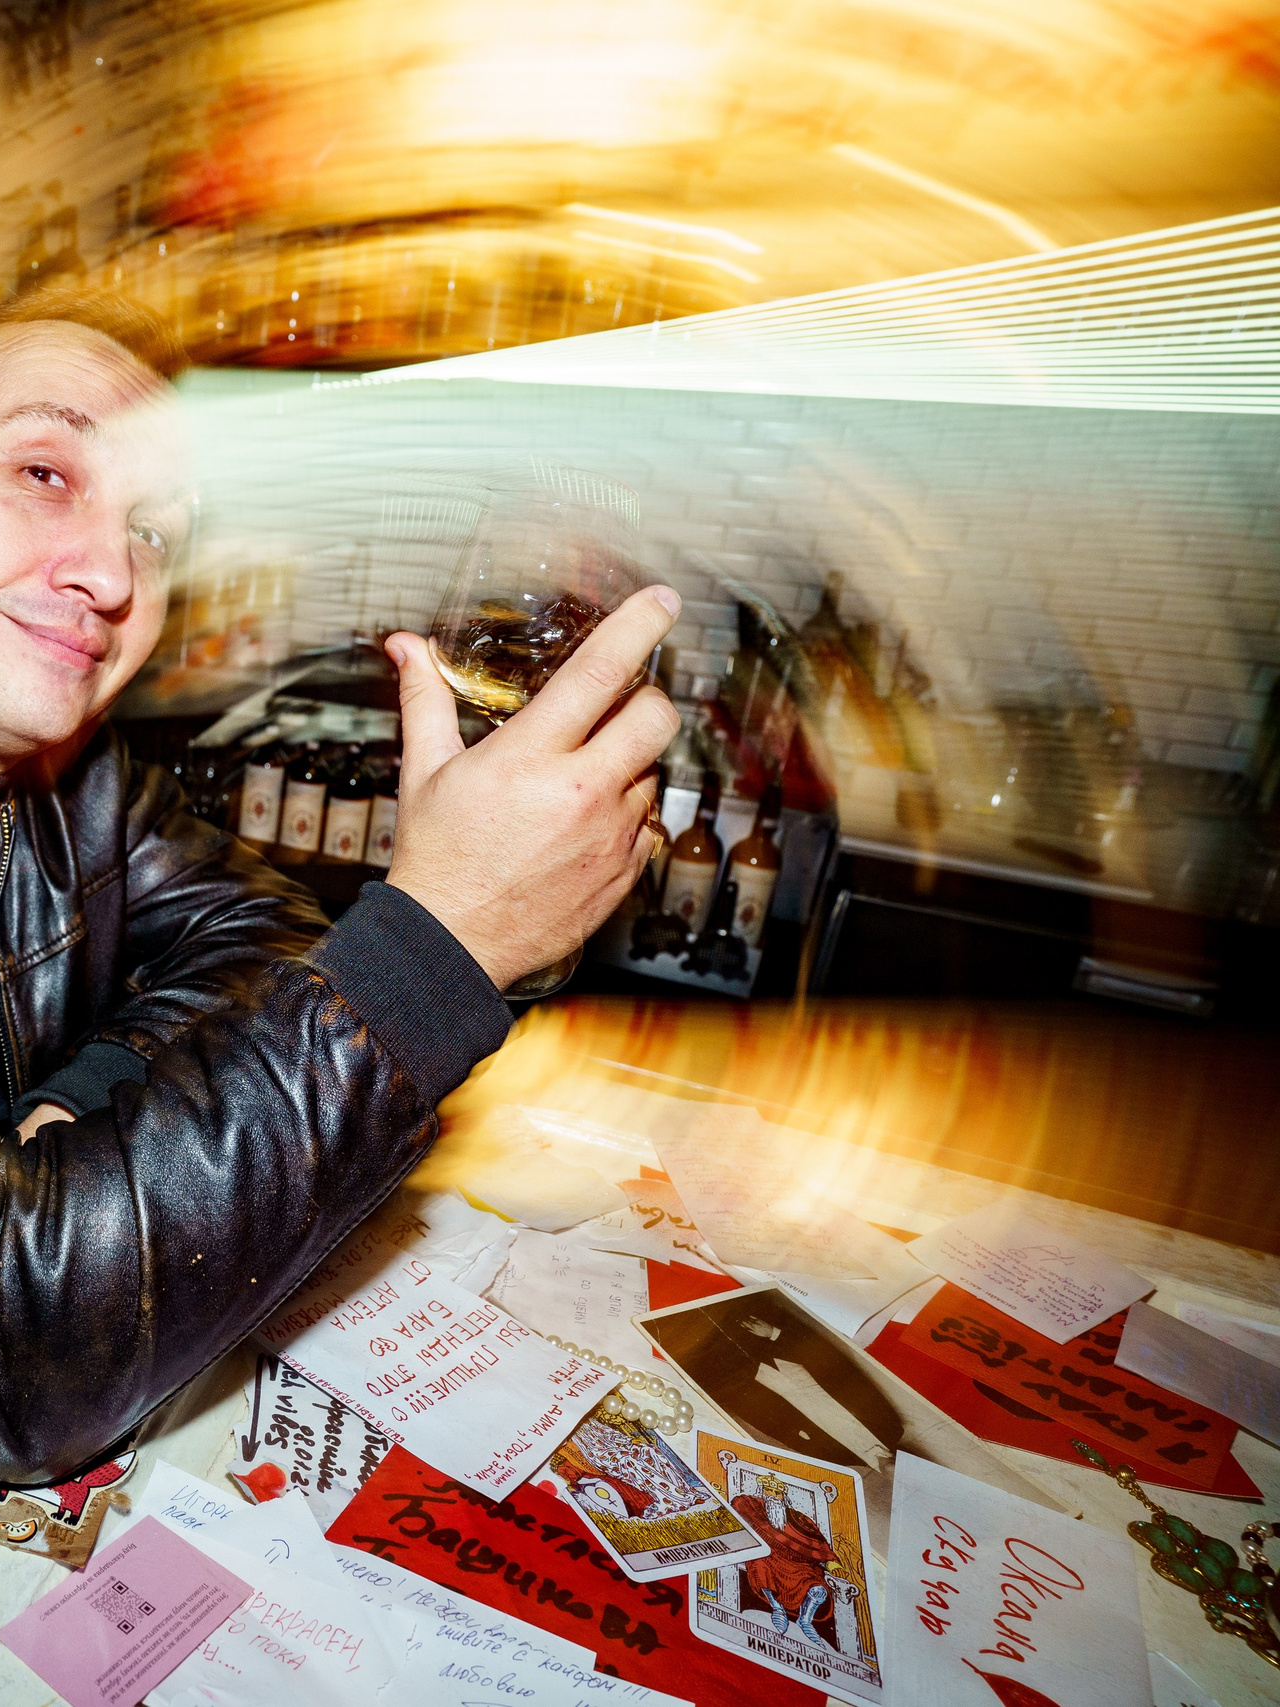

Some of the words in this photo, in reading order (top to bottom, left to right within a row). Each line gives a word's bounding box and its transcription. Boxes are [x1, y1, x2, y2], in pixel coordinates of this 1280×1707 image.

[403, 1261, 431, 1286] ОТ
[581, 1280, 591, 1290] СО
[330, 1281, 400, 1331] АРТЁМА
[573, 1297, 588, 1325] СЦЕНЫ
[607, 1295, 622, 1318] УПАЛ
[392, 1300, 453, 1338] БАРА
[416, 1304, 499, 1367] ЛЕГЕНДЫ
[495, 1316, 529, 1347] ВЫ
[366, 1364, 416, 1397] ЭТОГО
[404, 1345, 499, 1413] ЛУЧШИЕ!!!
[547, 1356, 582, 1384] АРТЁМ
[355, 1404, 375, 1420] ДЕНЬ
[383, 1427, 406, 1444] БЫЛ
[760, 1453, 783, 1466] IV
[122, 1543, 136, 1555] Буду
[652, 1539, 730, 1563] ИМПЕРАТРИЦА
[93, 1553, 124, 1578] благодарна
[337, 1559, 406, 1593] чего!
[60, 1582, 88, 1604] обратную
[186, 1583, 208, 1602] Позволь
[209, 1586, 220, 1596] Это
[217, 1592, 228, 1602] Это
[978, 1536, 1085, 1666] Оксана
[172, 1602, 187, 1615] миру
[189, 1595, 210, 1614] именно
[189, 1600, 218, 1628] украшение
[140, 1614, 174, 1644] насладиться
[162, 1631, 170, 1639] не
[169, 1621, 182, 1632] чего
[175, 1627, 191, 1642] такое
[239, 1590, 363, 1673] РЕКРАСЕН,
[122, 1644, 140, 1660] твоим
[141, 1637, 163, 1658] хватало
[167, 1641, 176, 1650] же
[249, 1635, 307, 1671] ПОКА
[120, 1658, 142, 1677] твоему
[135, 1647, 168, 1679] уникальное
[746, 1636, 832, 1681] ИМПЕРАТОР
[124, 1678, 135, 1688] как
[439, 1663, 535, 1697] любовью
[538, 1657, 617, 1692] кайфом
[109, 1692, 120, 1703] ты!
